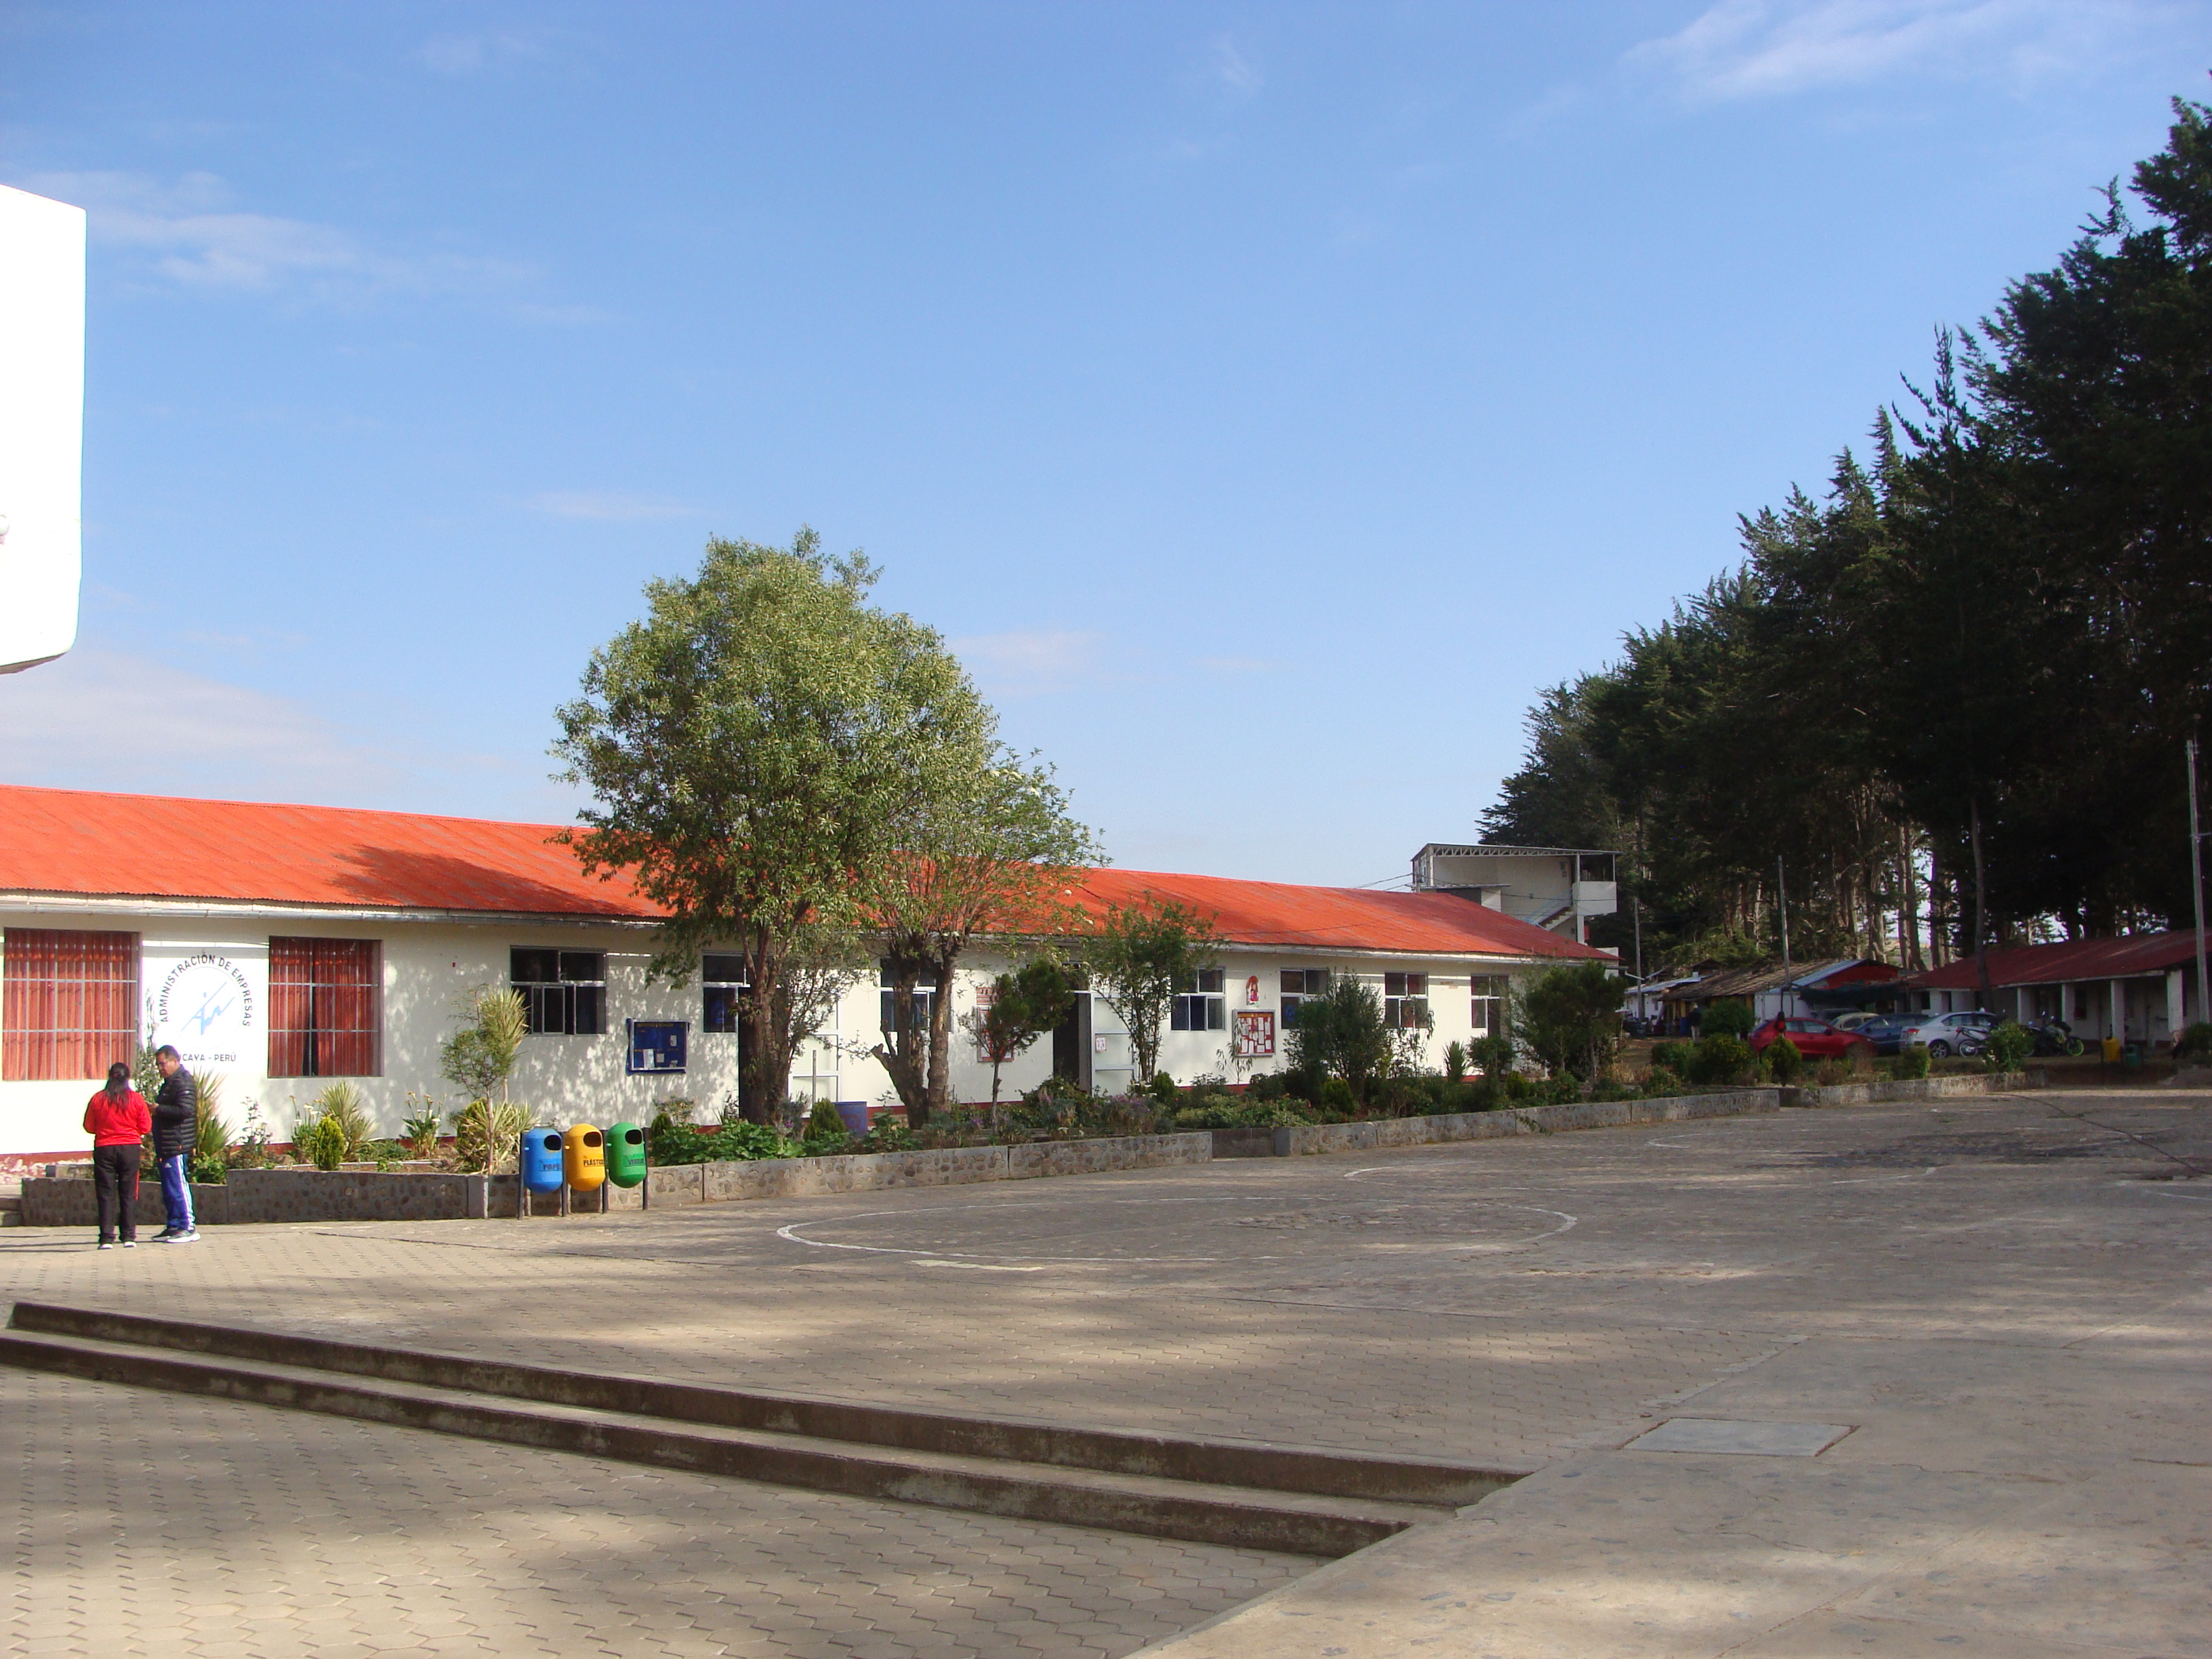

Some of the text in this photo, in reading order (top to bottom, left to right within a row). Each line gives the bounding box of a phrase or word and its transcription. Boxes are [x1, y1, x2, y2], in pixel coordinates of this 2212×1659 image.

[159, 951, 253, 1027] ADMINISTRACIÓN DE EMPRESAS
[214, 1052, 237, 1062] PERÚ
